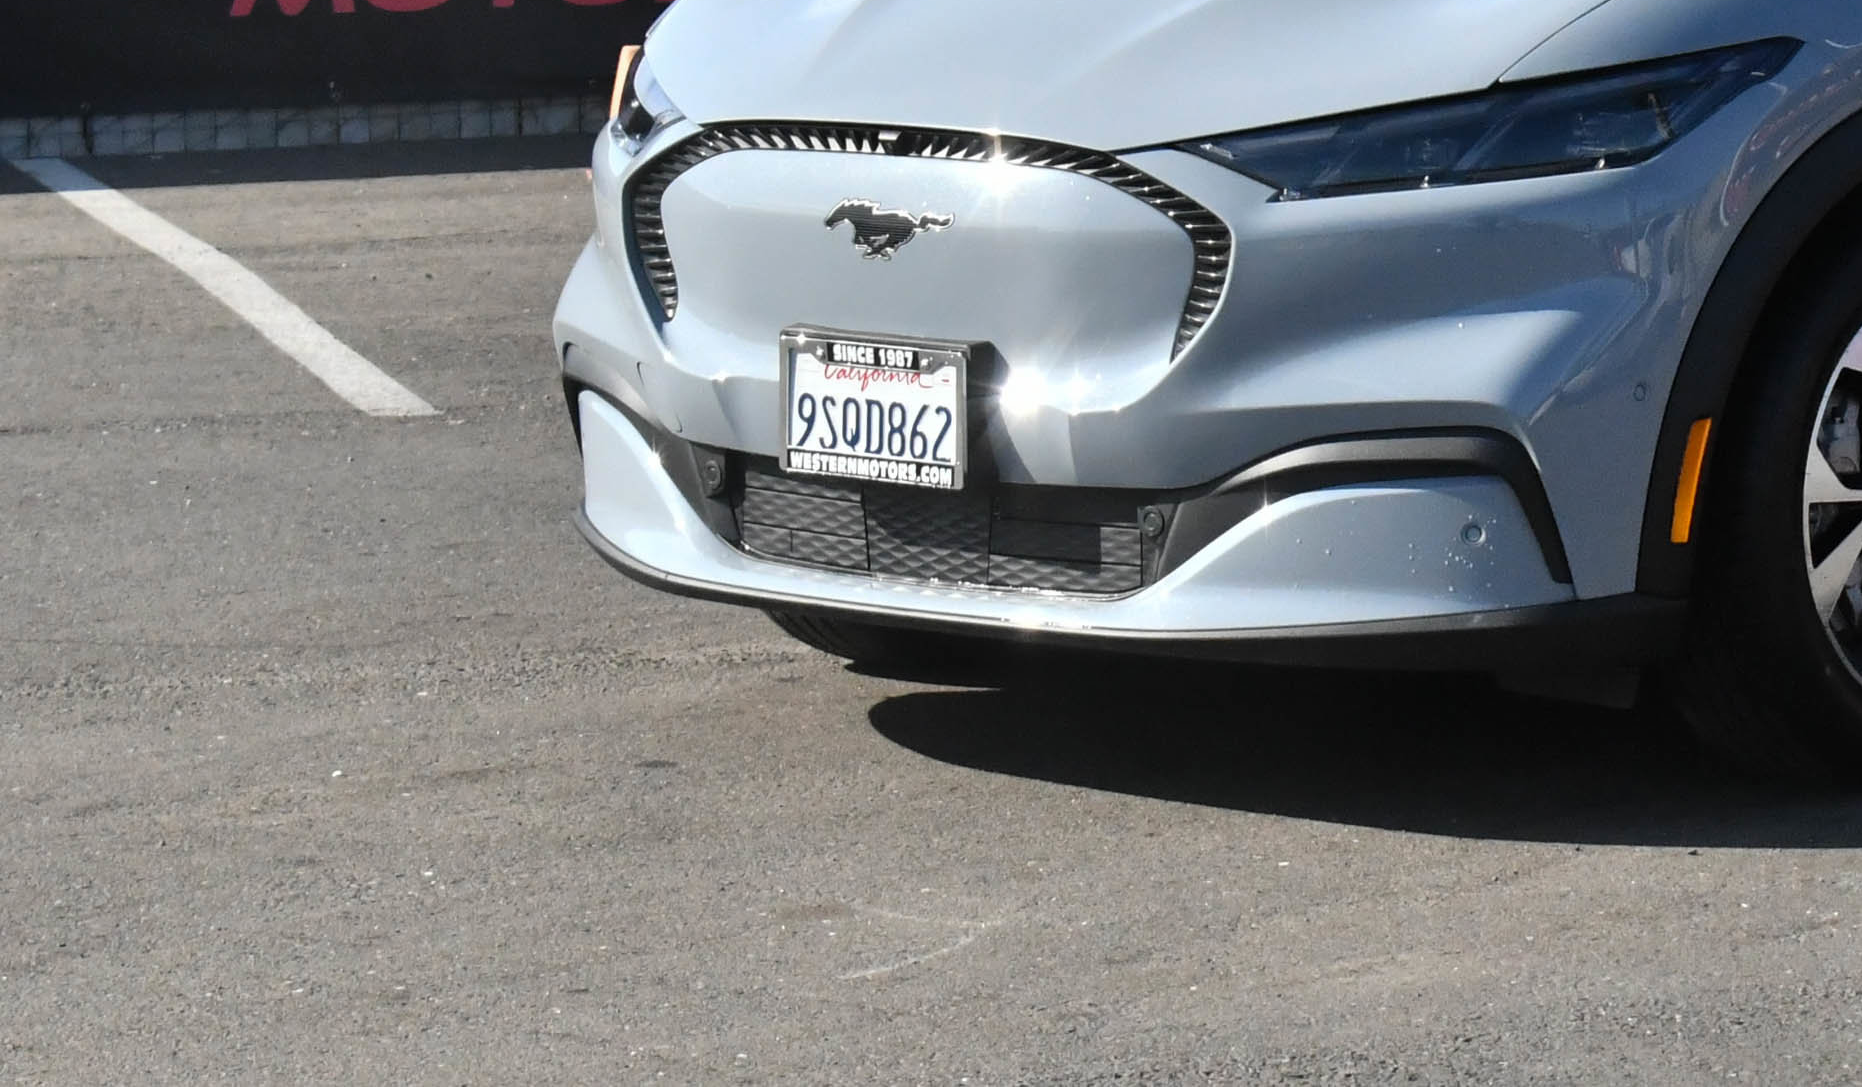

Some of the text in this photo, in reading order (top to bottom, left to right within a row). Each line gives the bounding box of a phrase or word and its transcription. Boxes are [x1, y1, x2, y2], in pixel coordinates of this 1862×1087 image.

[832, 343, 914, 368] SINCE 1987
[796, 393, 952, 462] 9SQD862
[790, 451, 953, 486] WESTERNMOTORS.COM
